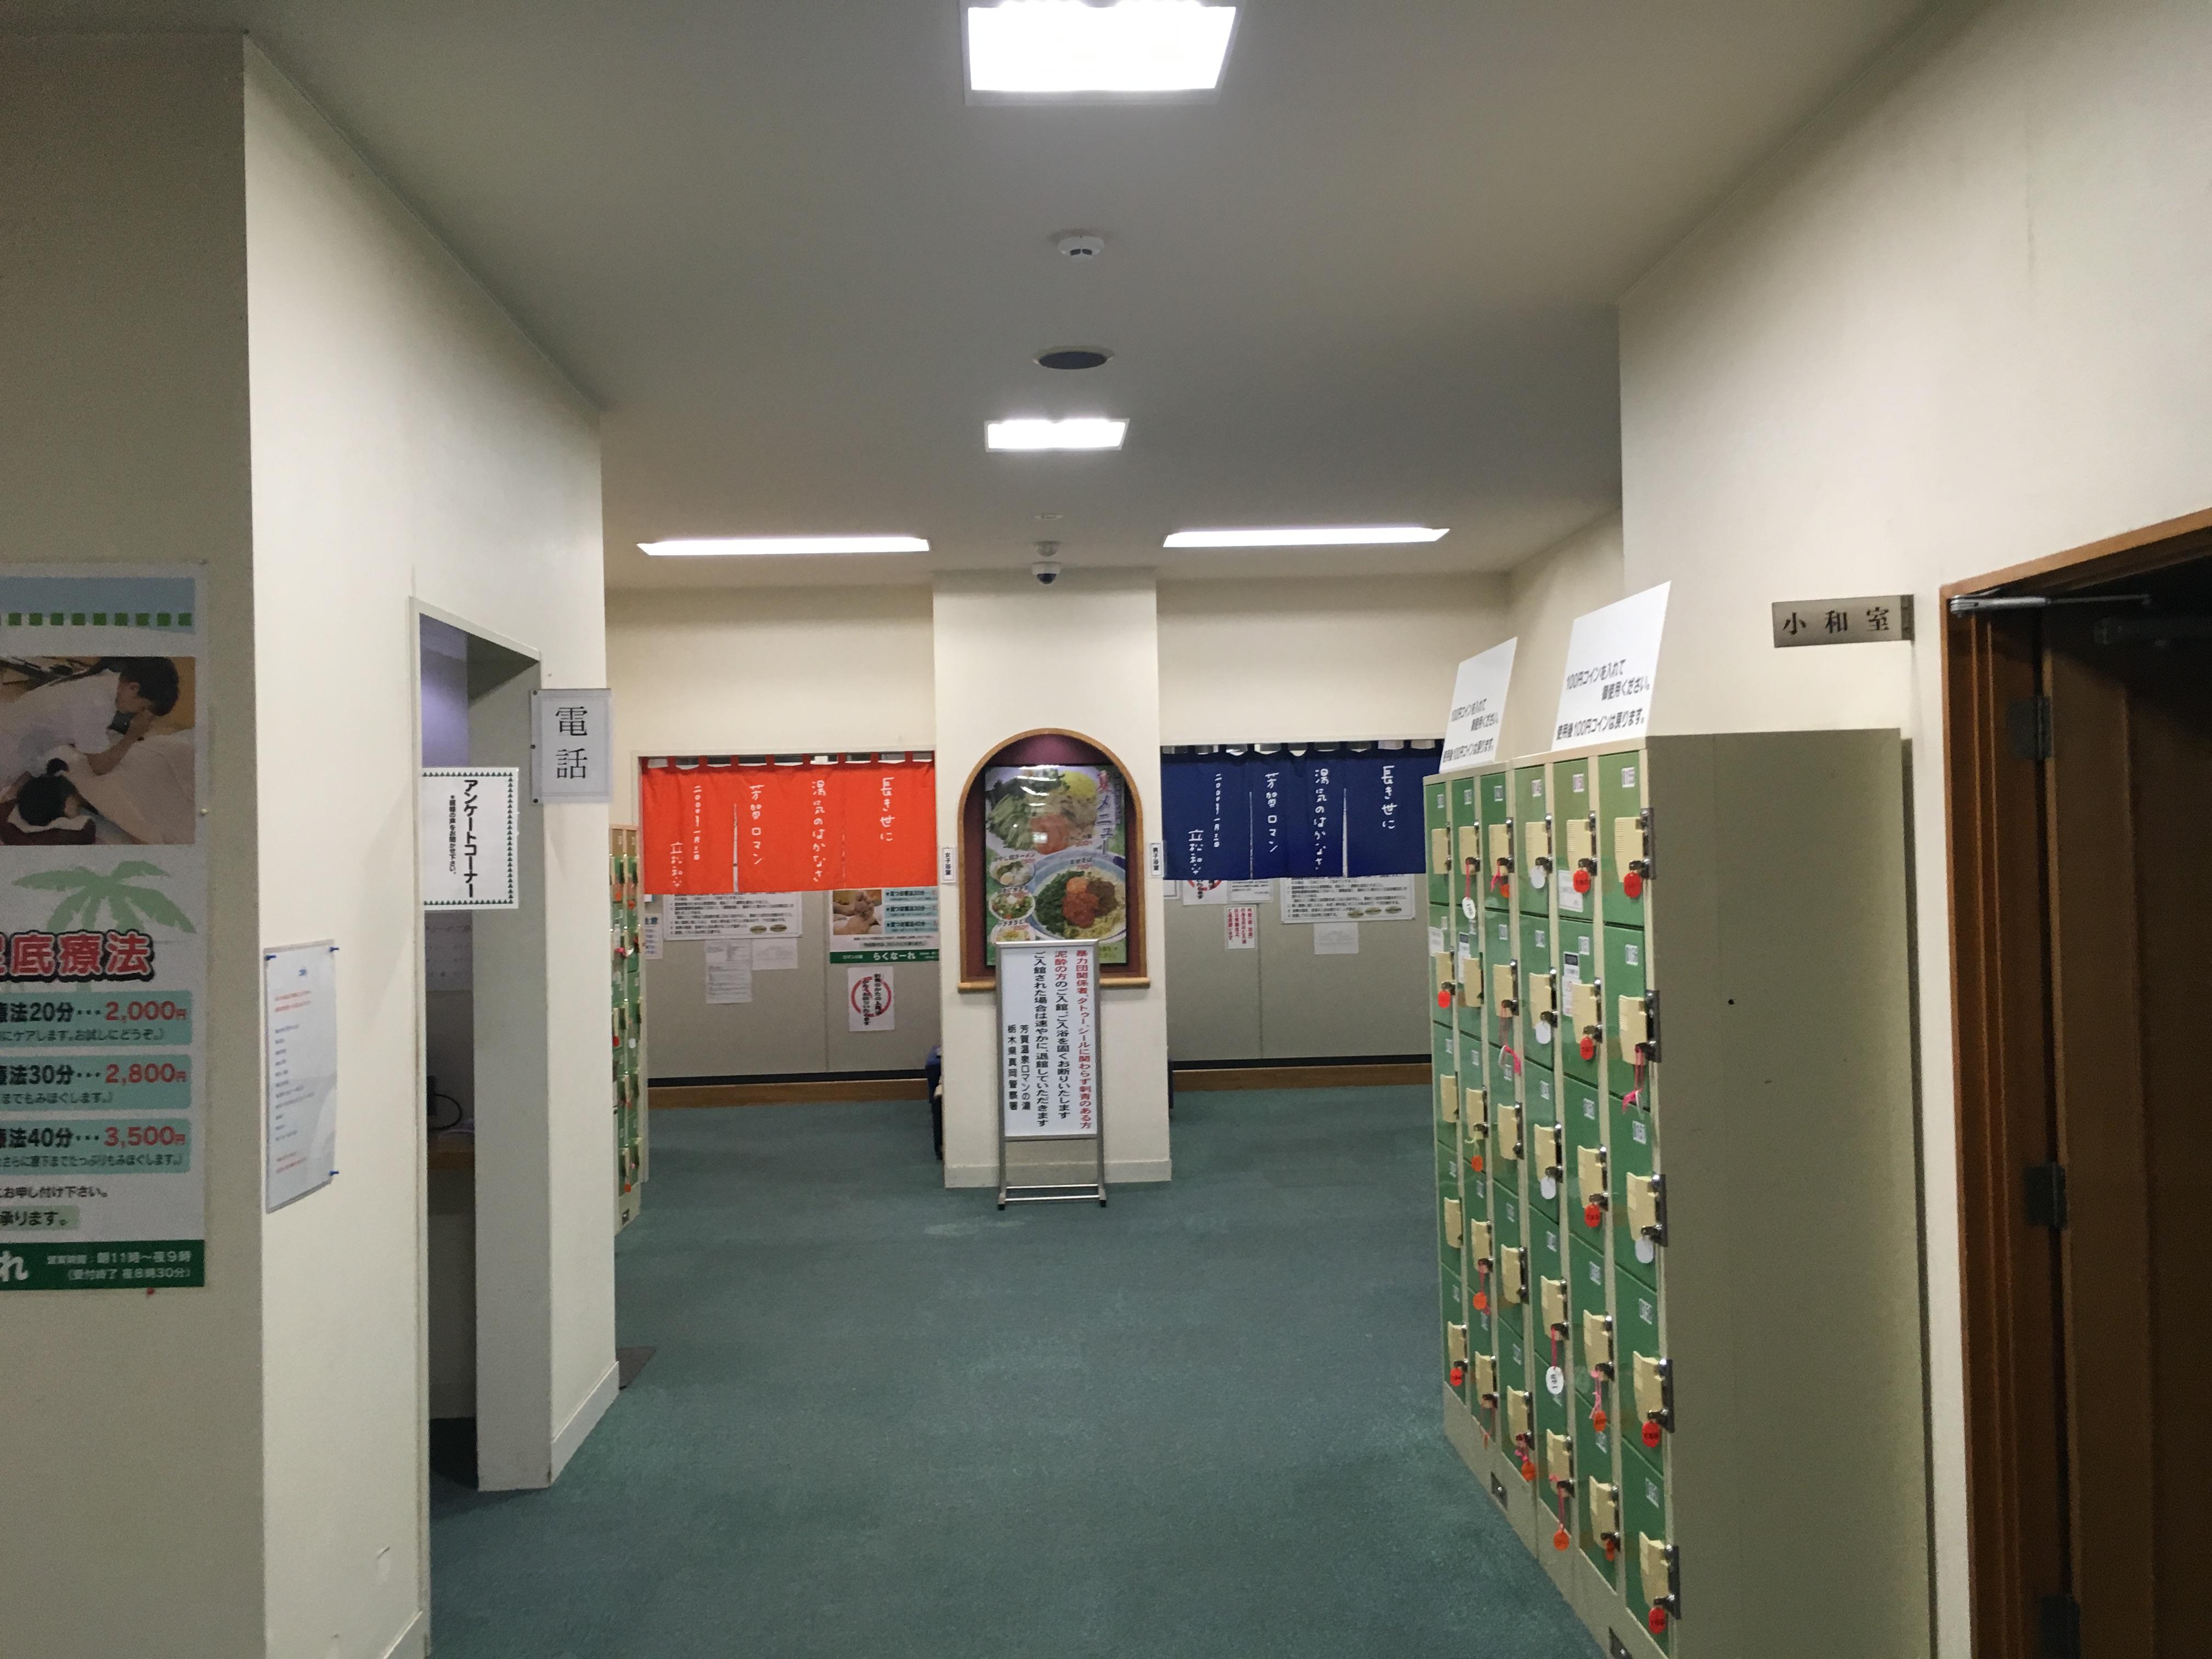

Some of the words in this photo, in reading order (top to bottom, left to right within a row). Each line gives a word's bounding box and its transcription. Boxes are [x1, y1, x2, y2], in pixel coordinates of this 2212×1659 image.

[1783, 607, 1889, 635] 小和室
[555, 706, 588, 779] 電話
[880, 777, 895, 842] 長き世に
[1381, 765, 1397, 828] 長き世に
[464, 780, 478, 898] アンケートコーナー
[0, 931, 153, 979] 底療法
[873, 951, 916, 960] らくなーれ
[1007, 1024, 1018, 1110] 栃木県真岡警察署
[1020, 1024, 1030, 1110] 芳賀温泉ロマンの湯
[0, 1185, 108, 1198] お申し付け下さい。
